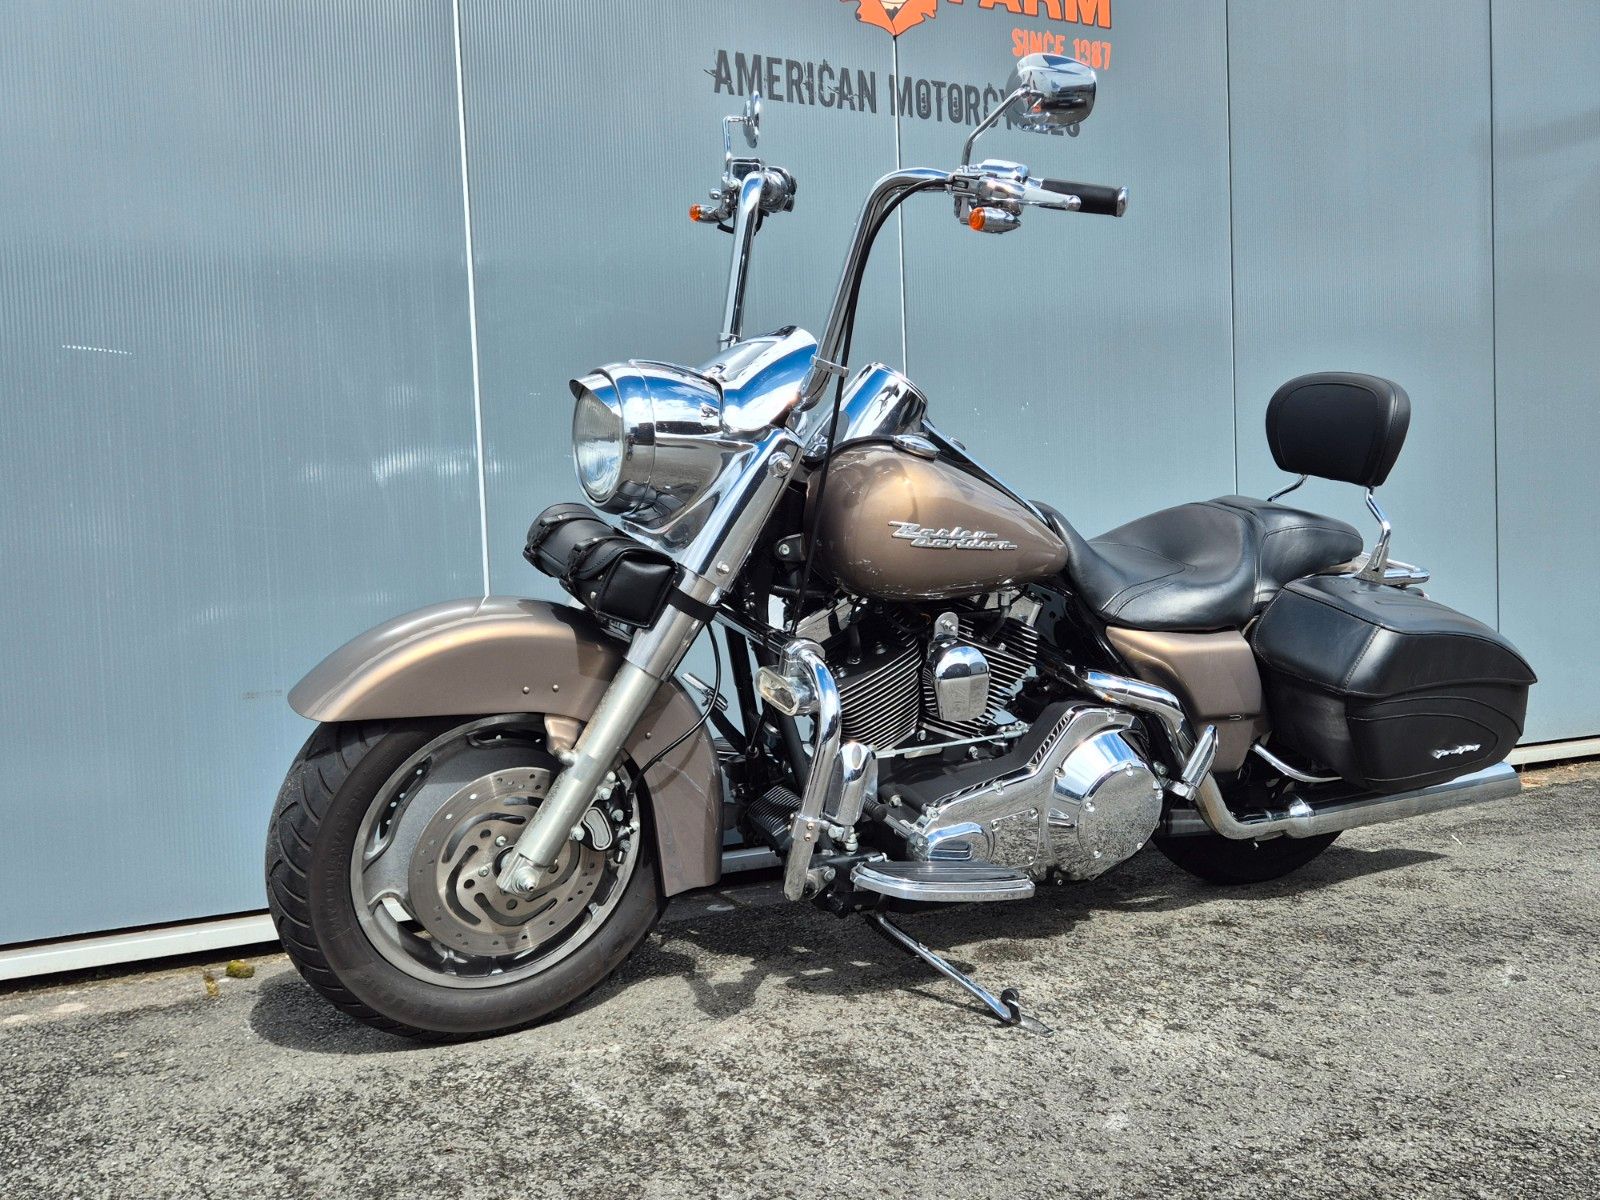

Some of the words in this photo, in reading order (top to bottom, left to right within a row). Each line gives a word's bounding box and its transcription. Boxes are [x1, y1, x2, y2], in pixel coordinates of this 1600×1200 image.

[1011, 27, 1066, 57] SINCE
[706, 49, 877, 114] AMERICAN
[889, 74, 1080, 137] MOTORC
